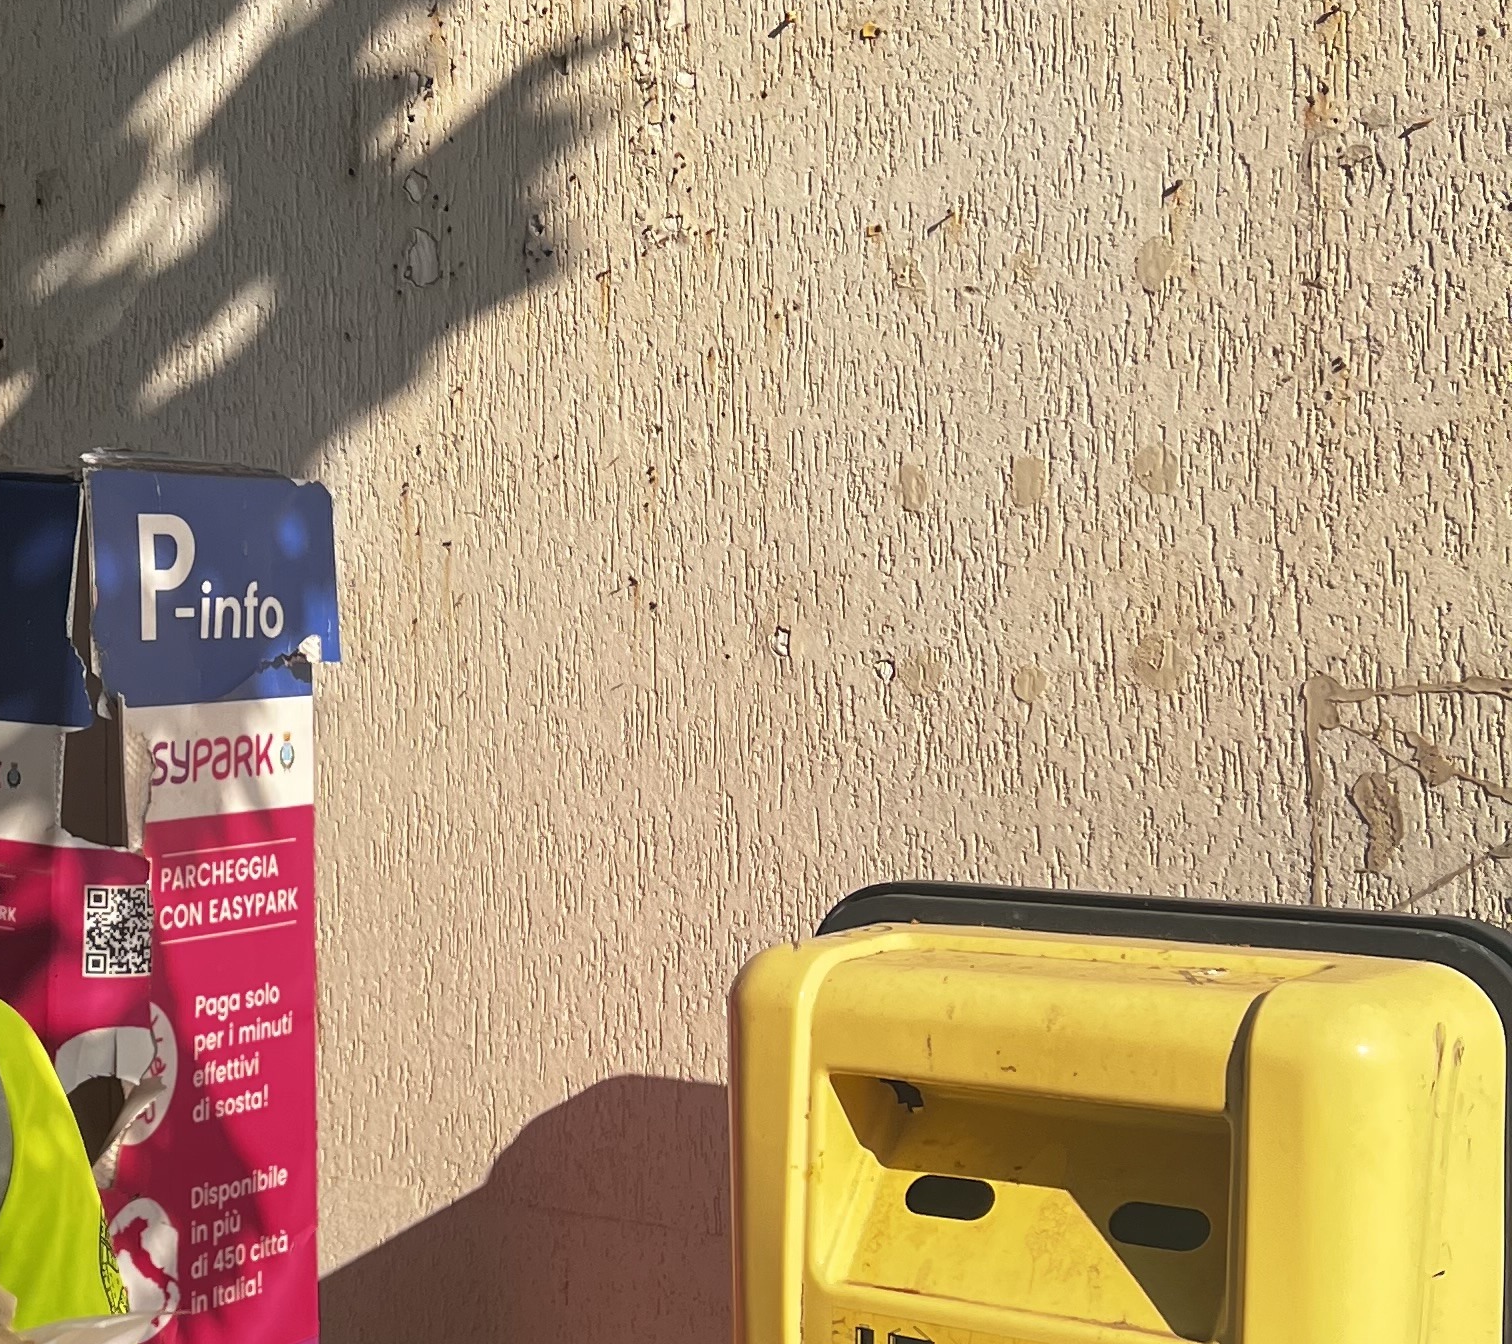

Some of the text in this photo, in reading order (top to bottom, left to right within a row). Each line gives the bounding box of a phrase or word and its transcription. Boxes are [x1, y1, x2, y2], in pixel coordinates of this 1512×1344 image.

[137, 513, 284, 642] P-info
[160, 854, 279, 893] PARCHEGGIA
[159, 887, 299, 931] CON EASYPARK
[194, 982, 281, 1022] Paga solo
[193, 1010, 293, 1060] per i minuti
[193, 1051, 260, 1088] effettivi
[192, 1084, 269, 1124] di sosta!
[191, 1166, 288, 1210] Disponibile
[191, 1209, 241, 1245] in più
[191, 1229, 289, 1280] di 450 città
[191, 1271, 264, 1315] in Italia!
